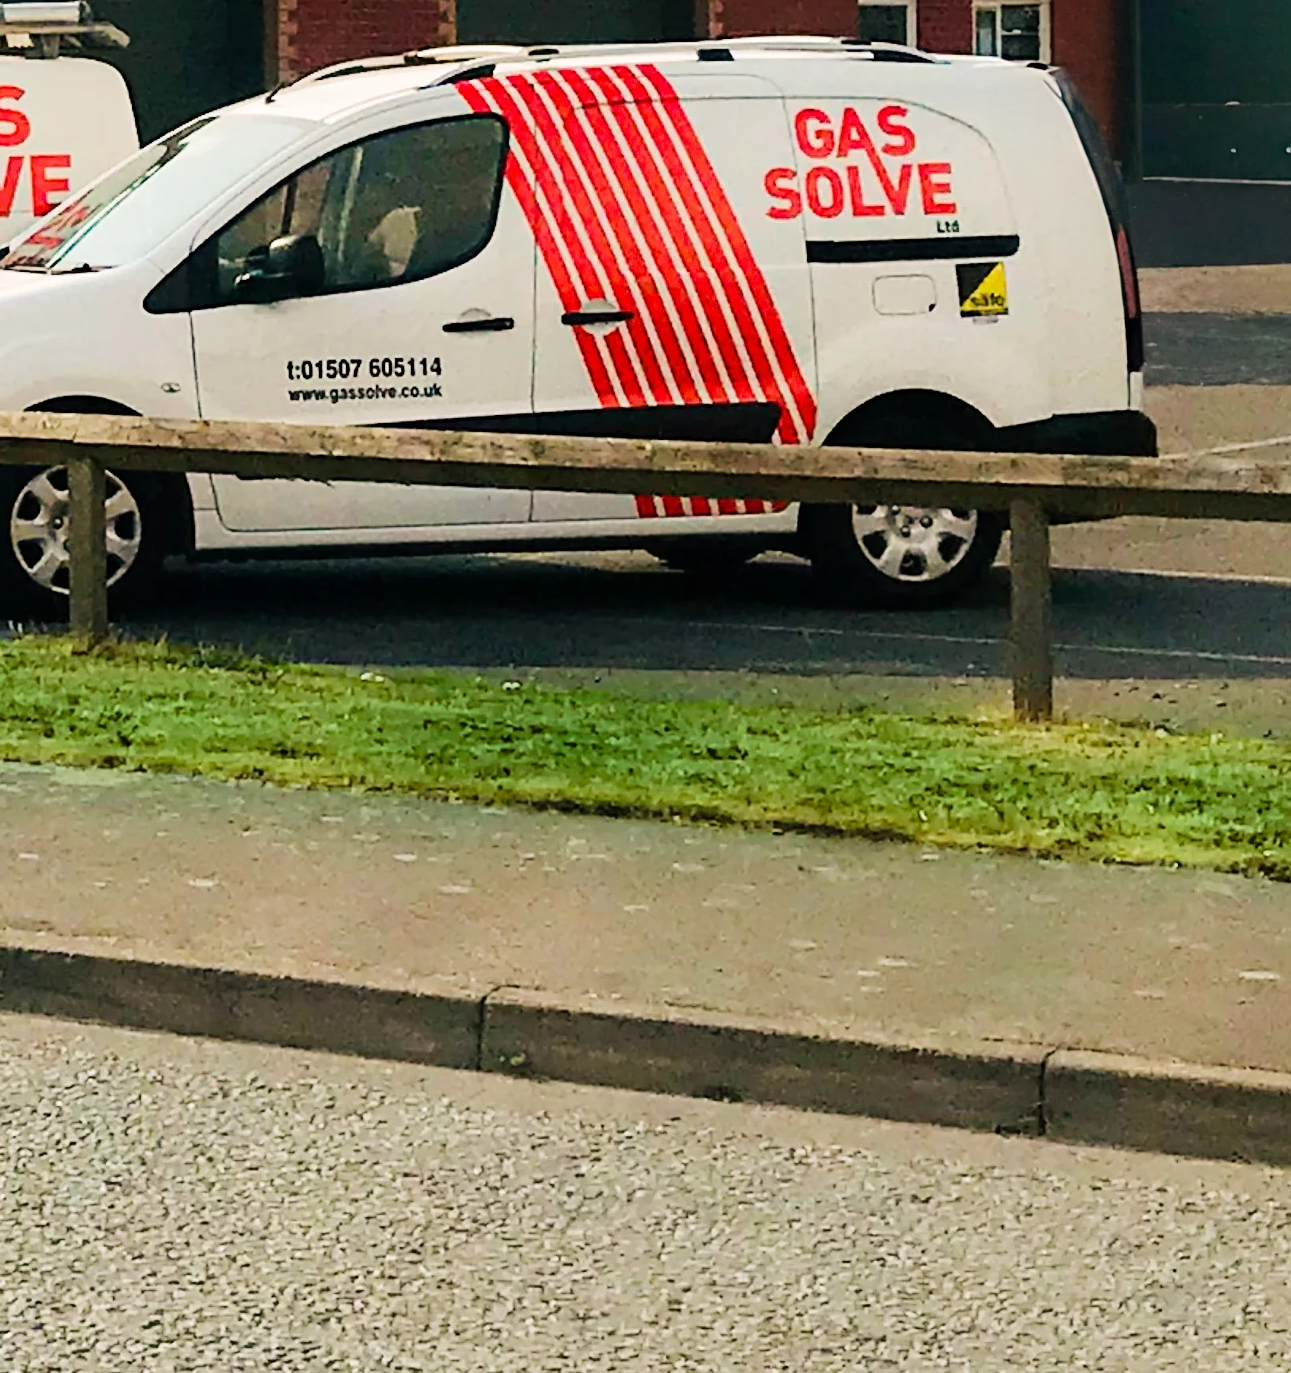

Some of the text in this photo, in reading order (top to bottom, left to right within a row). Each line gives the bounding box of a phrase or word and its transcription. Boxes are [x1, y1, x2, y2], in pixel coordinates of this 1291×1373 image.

[794, 105, 916, 159] GAS
[764, 162, 957, 220] SOLVE
[936, 219, 960, 233] Ltd
[287, 357, 442, 380] t:01507 605114
[288, 383, 443, 404] www.gassolve.co.uk
